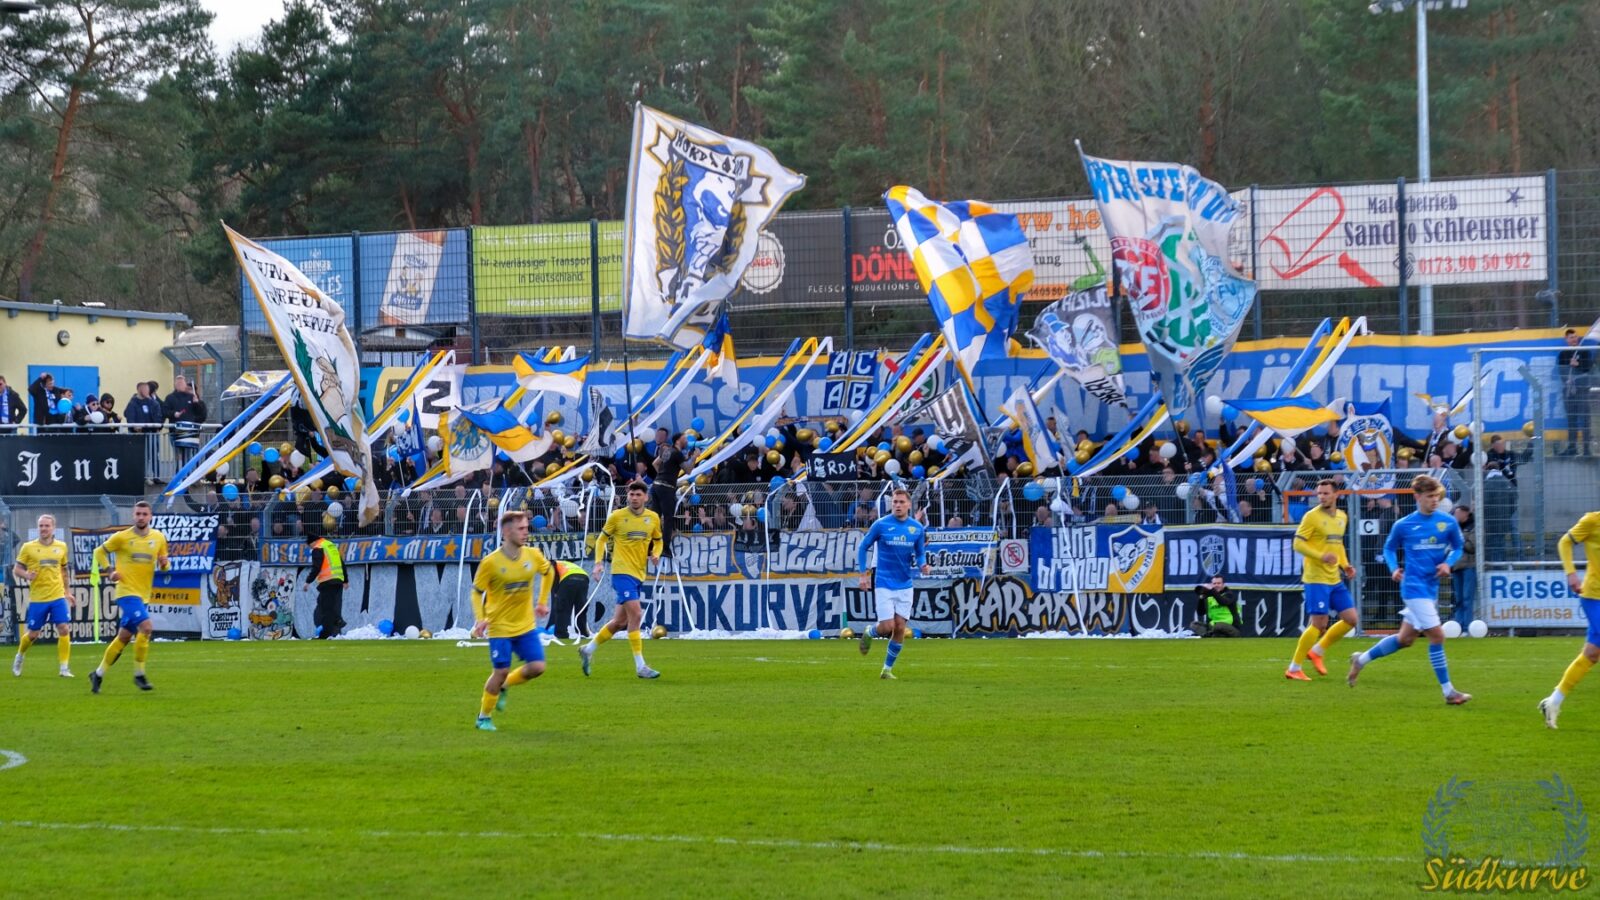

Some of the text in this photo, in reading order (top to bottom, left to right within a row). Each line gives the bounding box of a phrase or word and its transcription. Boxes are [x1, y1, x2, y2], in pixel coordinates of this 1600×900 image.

[1344, 216, 1539, 247] Sando Schleusner
[1482, 253, 1501, 271] 50
[1505, 252, 1531, 270] 912
[18, 451, 119, 487] Jena
[148, 515, 219, 528] UKUNFTS
[1363, 520, 1374, 533] C
[403, 540, 441, 560] MIT
[940, 549, 985, 569] Festung
[1490, 575, 1579, 599] Reise
[1490, 605, 1572, 619] Lufthansa
